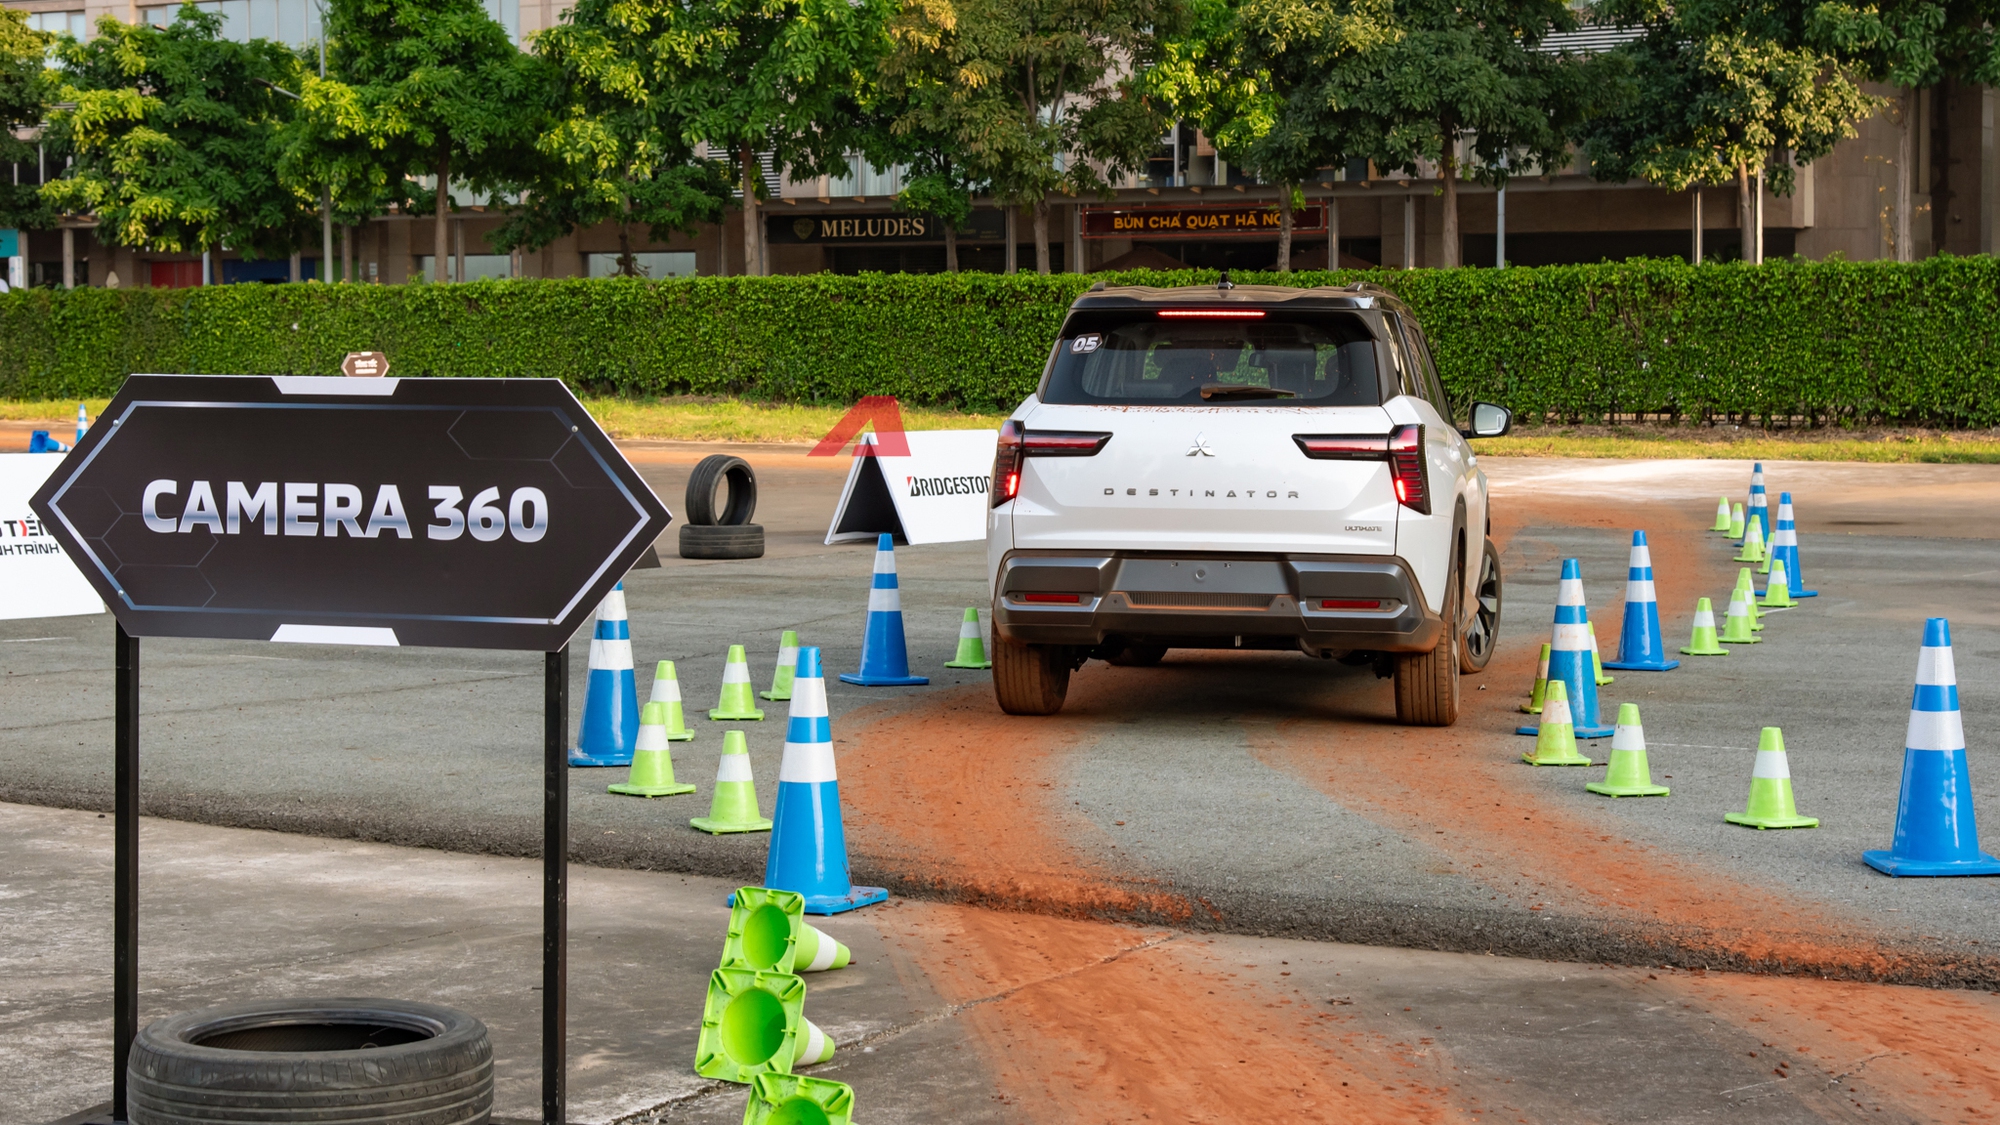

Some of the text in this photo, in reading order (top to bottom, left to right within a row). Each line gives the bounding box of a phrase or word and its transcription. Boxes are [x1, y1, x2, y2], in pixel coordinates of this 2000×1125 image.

[821, 217, 926, 238] MELUDES
[1186, 214, 1231, 230] QUẠT
[1072, 336, 1099, 352] 05
[906, 475, 991, 497] BRIDGESTON
[1103, 487, 1300, 499] DESTINATOR
[142, 479, 549, 543] CAMERA 360
[14, 540, 60, 555] TRÌNH
